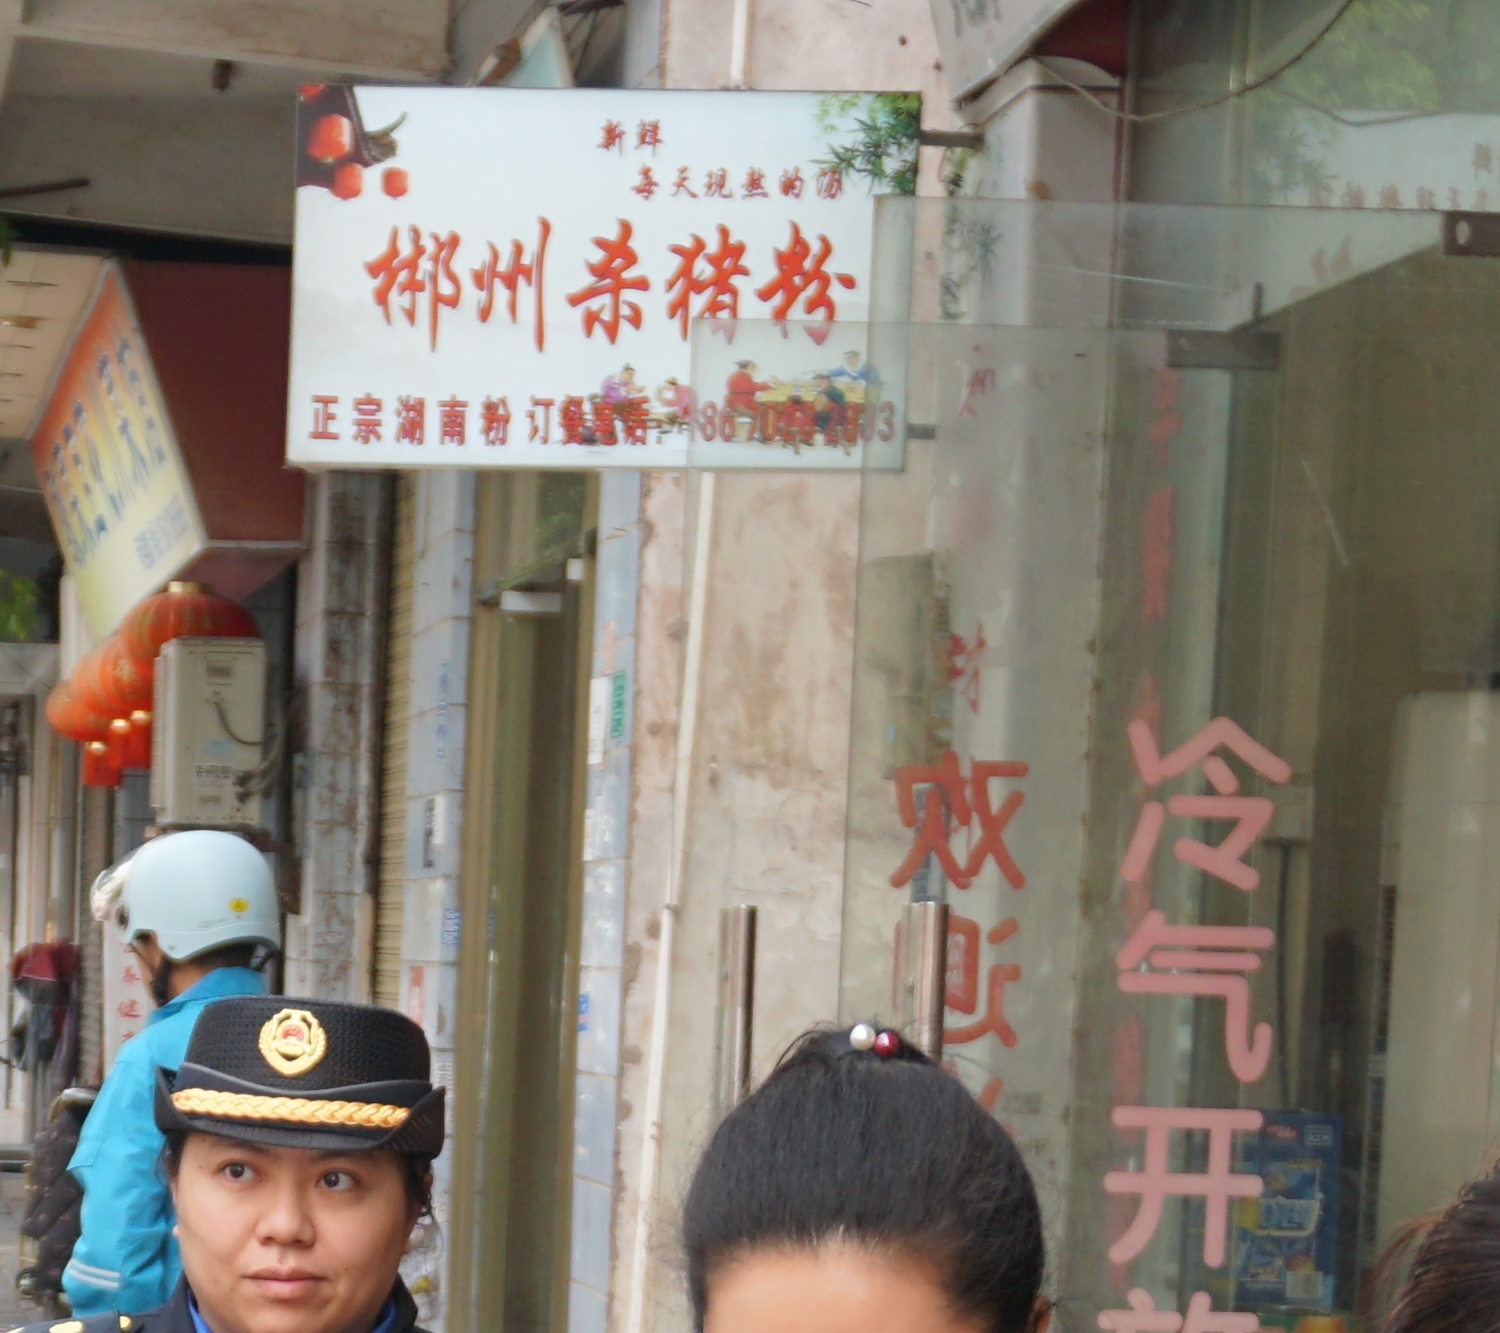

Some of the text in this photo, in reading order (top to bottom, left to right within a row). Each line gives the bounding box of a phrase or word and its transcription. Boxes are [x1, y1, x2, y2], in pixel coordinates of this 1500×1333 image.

[596, 119, 663, 157] 新鲜
[362, 216, 856, 353] 郴州杀猪粉
[308, 394, 511, 445] 正宗湖南粉
